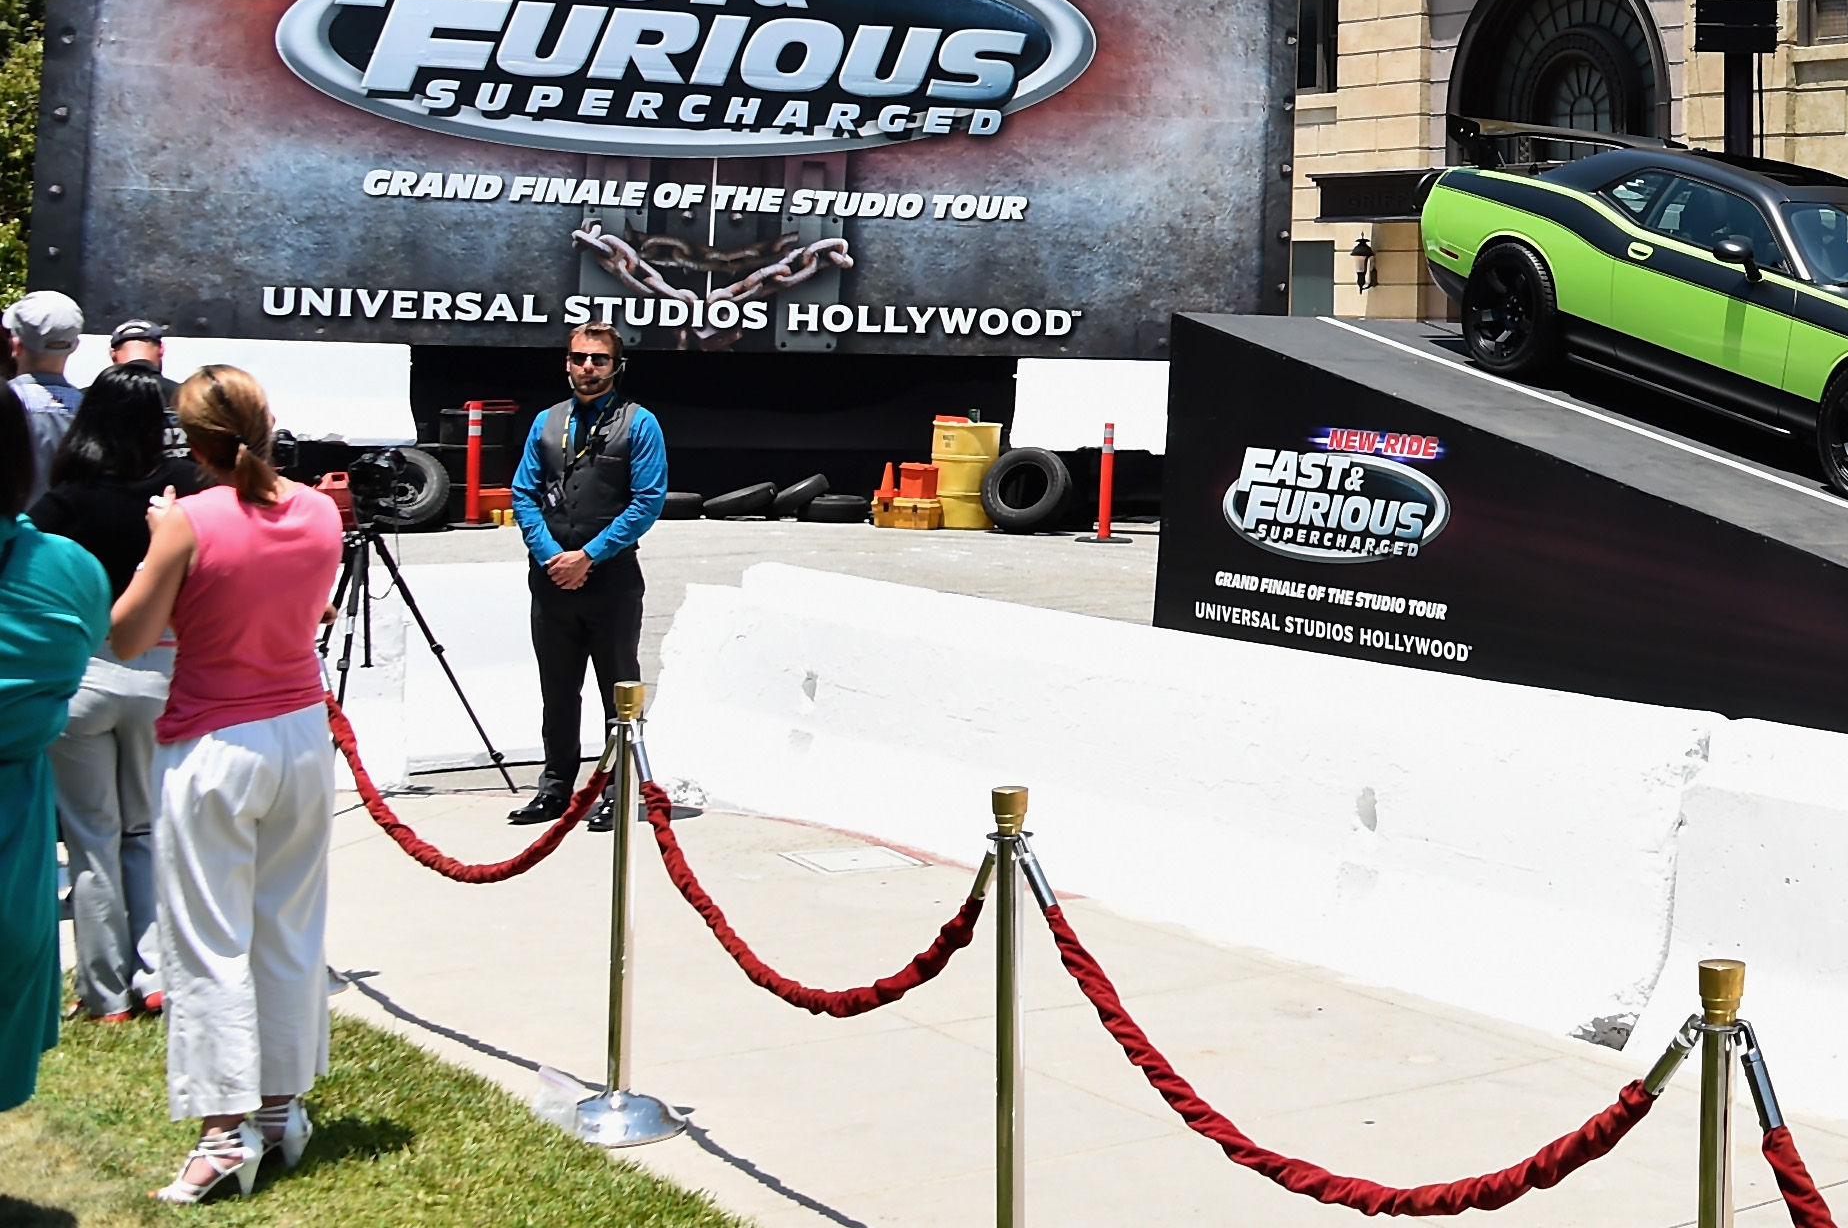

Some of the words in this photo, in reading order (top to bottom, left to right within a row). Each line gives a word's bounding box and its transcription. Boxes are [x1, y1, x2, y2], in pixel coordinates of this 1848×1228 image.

[422, 78, 1003, 137] SUPERCHARGED
[362, 169, 502, 202] GRAND
[508, 176, 646, 208] FINALE
[653, 183, 706, 210] OF
[713, 184, 785, 212] THE
[789, 188, 925, 219] STUDIO
[931, 194, 1028, 221] TOUR
[262, 287, 548, 323] UNIVERSAL
[563, 294, 768, 330] STUDIOS
[1327, 428, 1381, 453] NEW
[1384, 433, 1439, 457] RIDE
[1237, 447, 1351, 491] FAST
[1345, 466, 1365, 492] &
[1243, 485, 1427, 538] FURIOUS
[1257, 522, 1419, 557] SUPERCHARGED
[1215, 571, 1259, 593] GRAND
[1260, 577, 1305, 600] FINALE
[1307, 584, 1326, 601] OF
[1328, 587, 1354, 606] THE
[1356, 591, 1406, 614] STUDIO
[1408, 599, 1448, 621] TOUR
[1195, 601, 1281, 633] UNIVERSAL
[1284, 615, 1354, 644] STUDIOS
